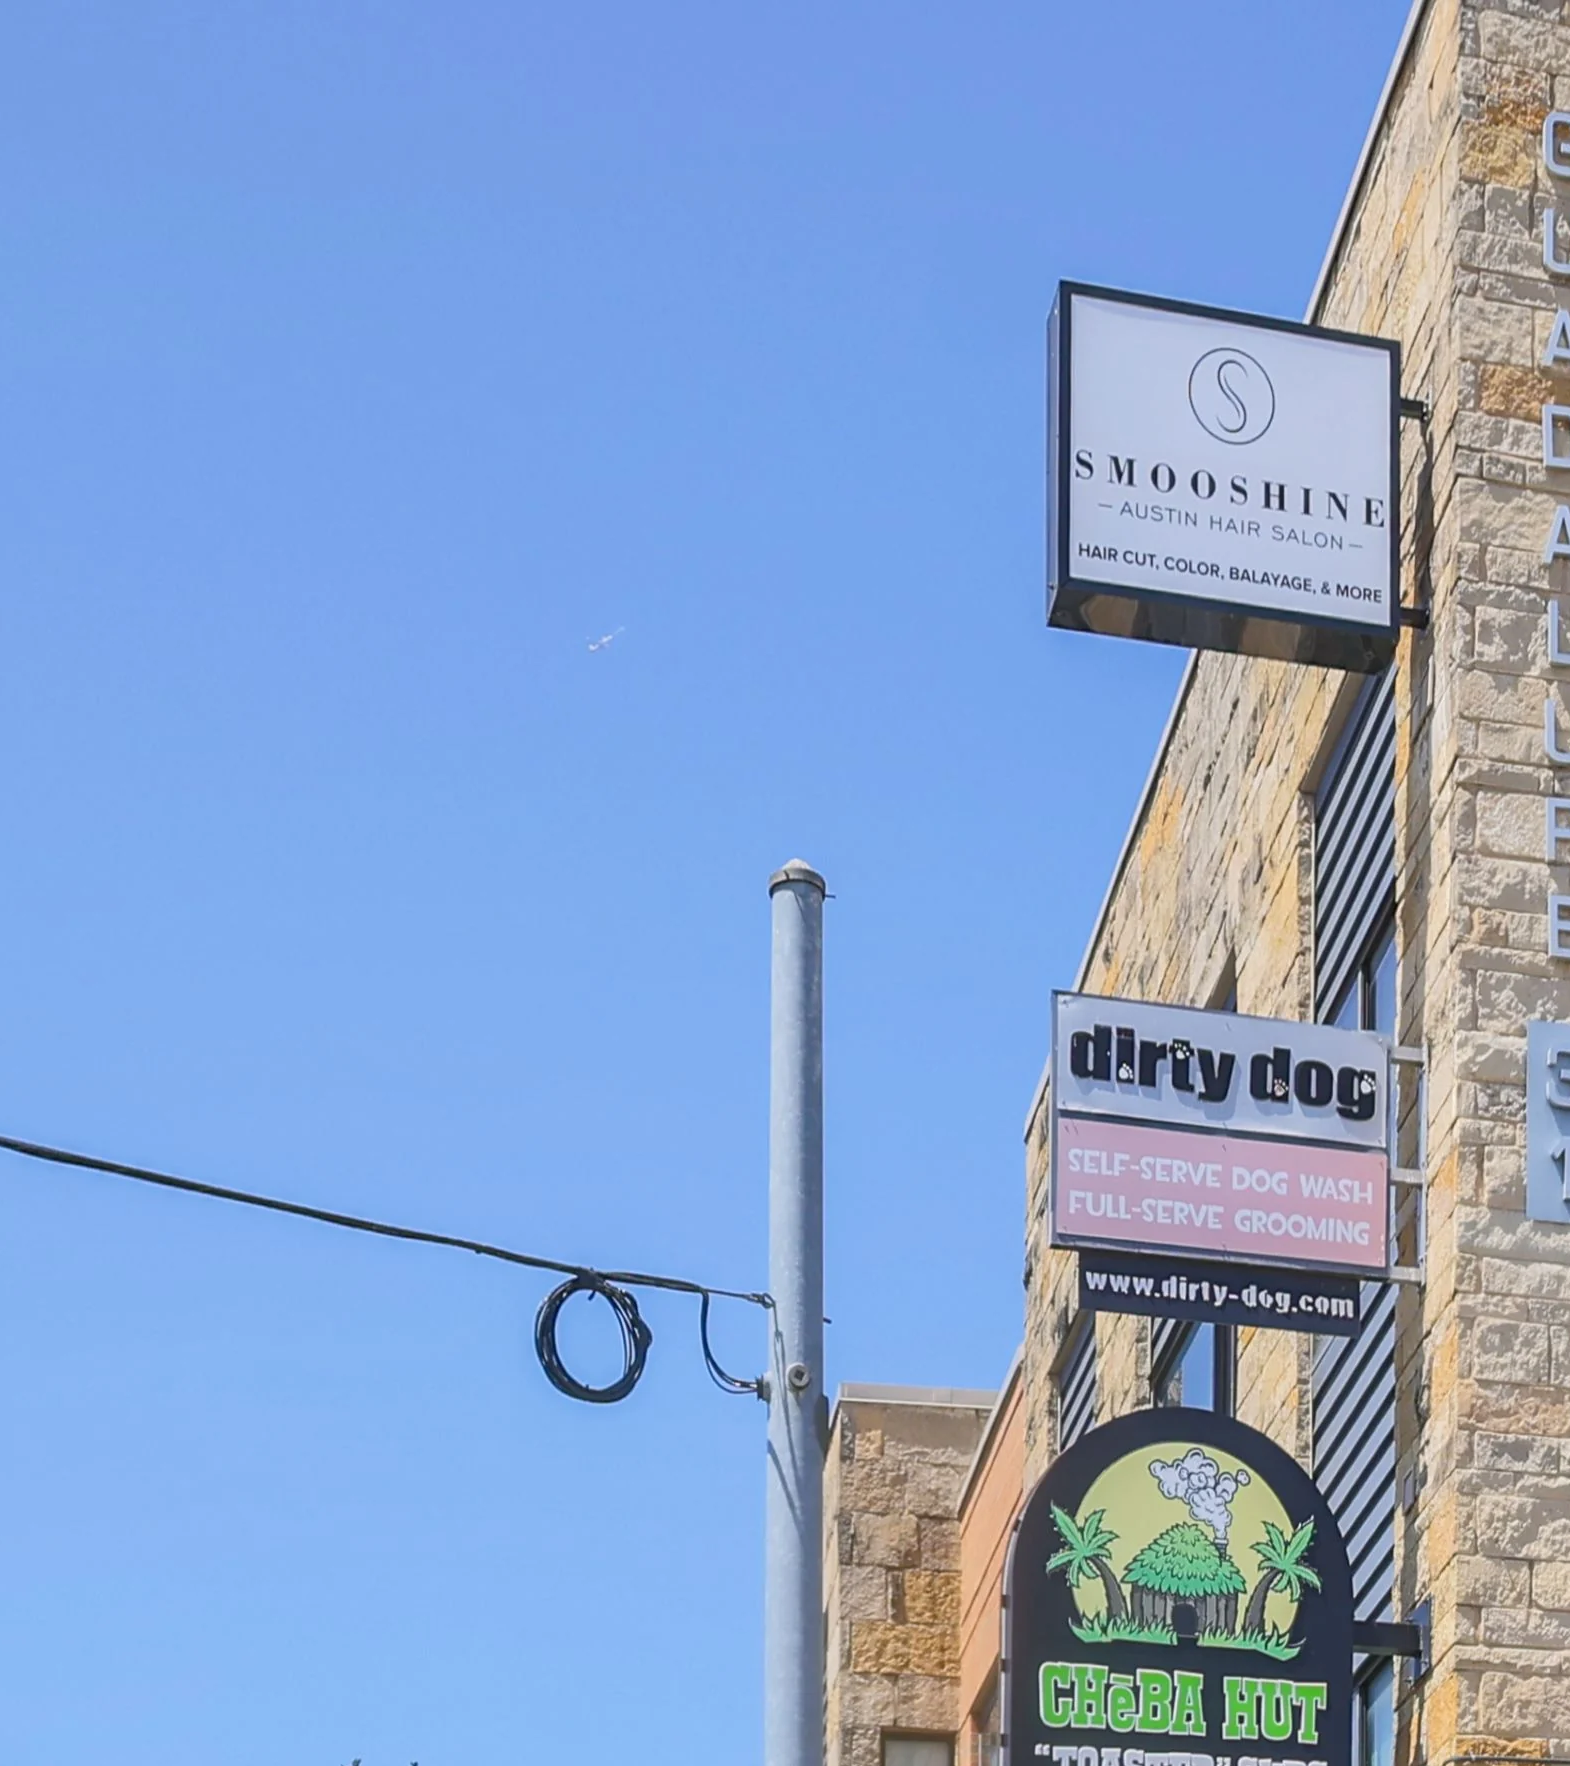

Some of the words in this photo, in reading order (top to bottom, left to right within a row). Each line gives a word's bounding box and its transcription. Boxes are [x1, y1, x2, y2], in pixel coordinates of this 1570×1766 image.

[1074, 449, 1386, 529] SMOOSHINE
[1119, 499, 1198, 529] AUSTIN
[1209, 514, 1261, 538] HAIR
[1271, 523, 1344, 551] SALON
[1078, 542, 1118, 562] HAIR
[1123, 549, 1160, 571] CUT,
[1164, 556, 1225, 581] COLOR,
[1229, 566, 1317, 597] BALAYAGE,
[1321, 581, 1332, 597] &
[1336, 583, 1383, 604] MORE
[1249, 1046, 1378, 1121] dog
[1067, 1148, 1223, 1189] SELF-SERVE
[1231, 1166, 1289, 1196] DOG
[1299, 1173, 1374, 1205] WASH
[1068, 1191, 1224, 1230] FULL-SERVE
[1233, 1208, 1371, 1246] GROOMING
[1085, 1270, 1355, 1319] www.dirty-dog.com
[1222, 1675, 1328, 1745] HUT
